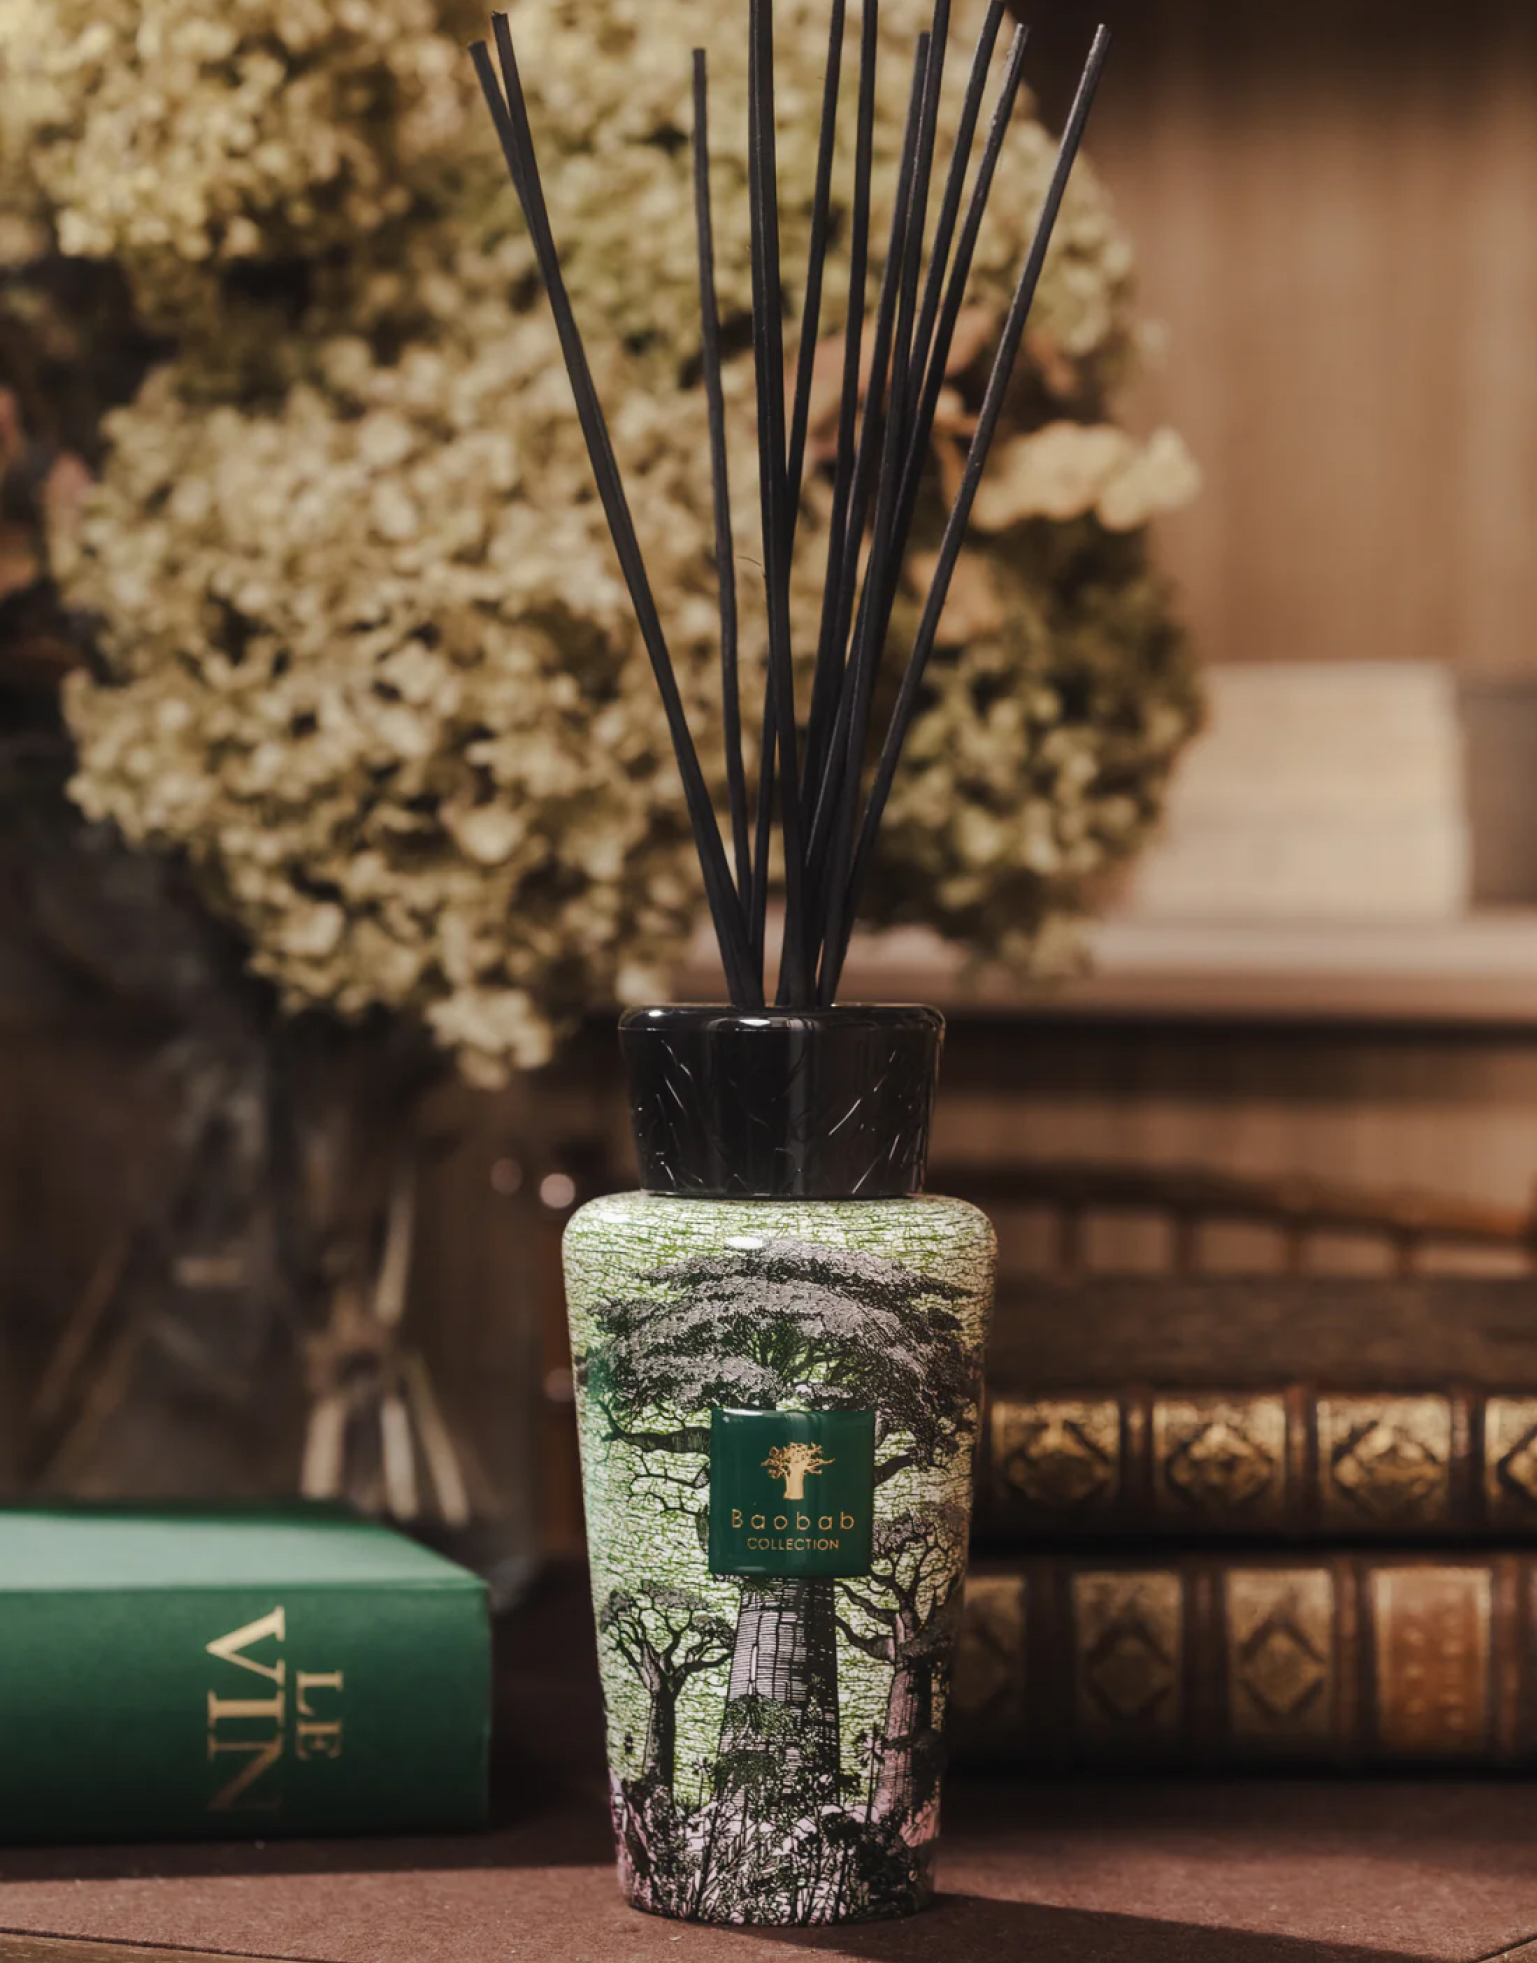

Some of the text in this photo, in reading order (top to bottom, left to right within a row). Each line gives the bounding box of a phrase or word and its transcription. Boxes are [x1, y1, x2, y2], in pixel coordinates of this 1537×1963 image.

[731, 1508, 855, 1531] Baobab
[746, 1537, 840, 1551] COLLECTION
[205, 1604, 286, 1814] VIN
[295, 1669, 344, 1761] LE
